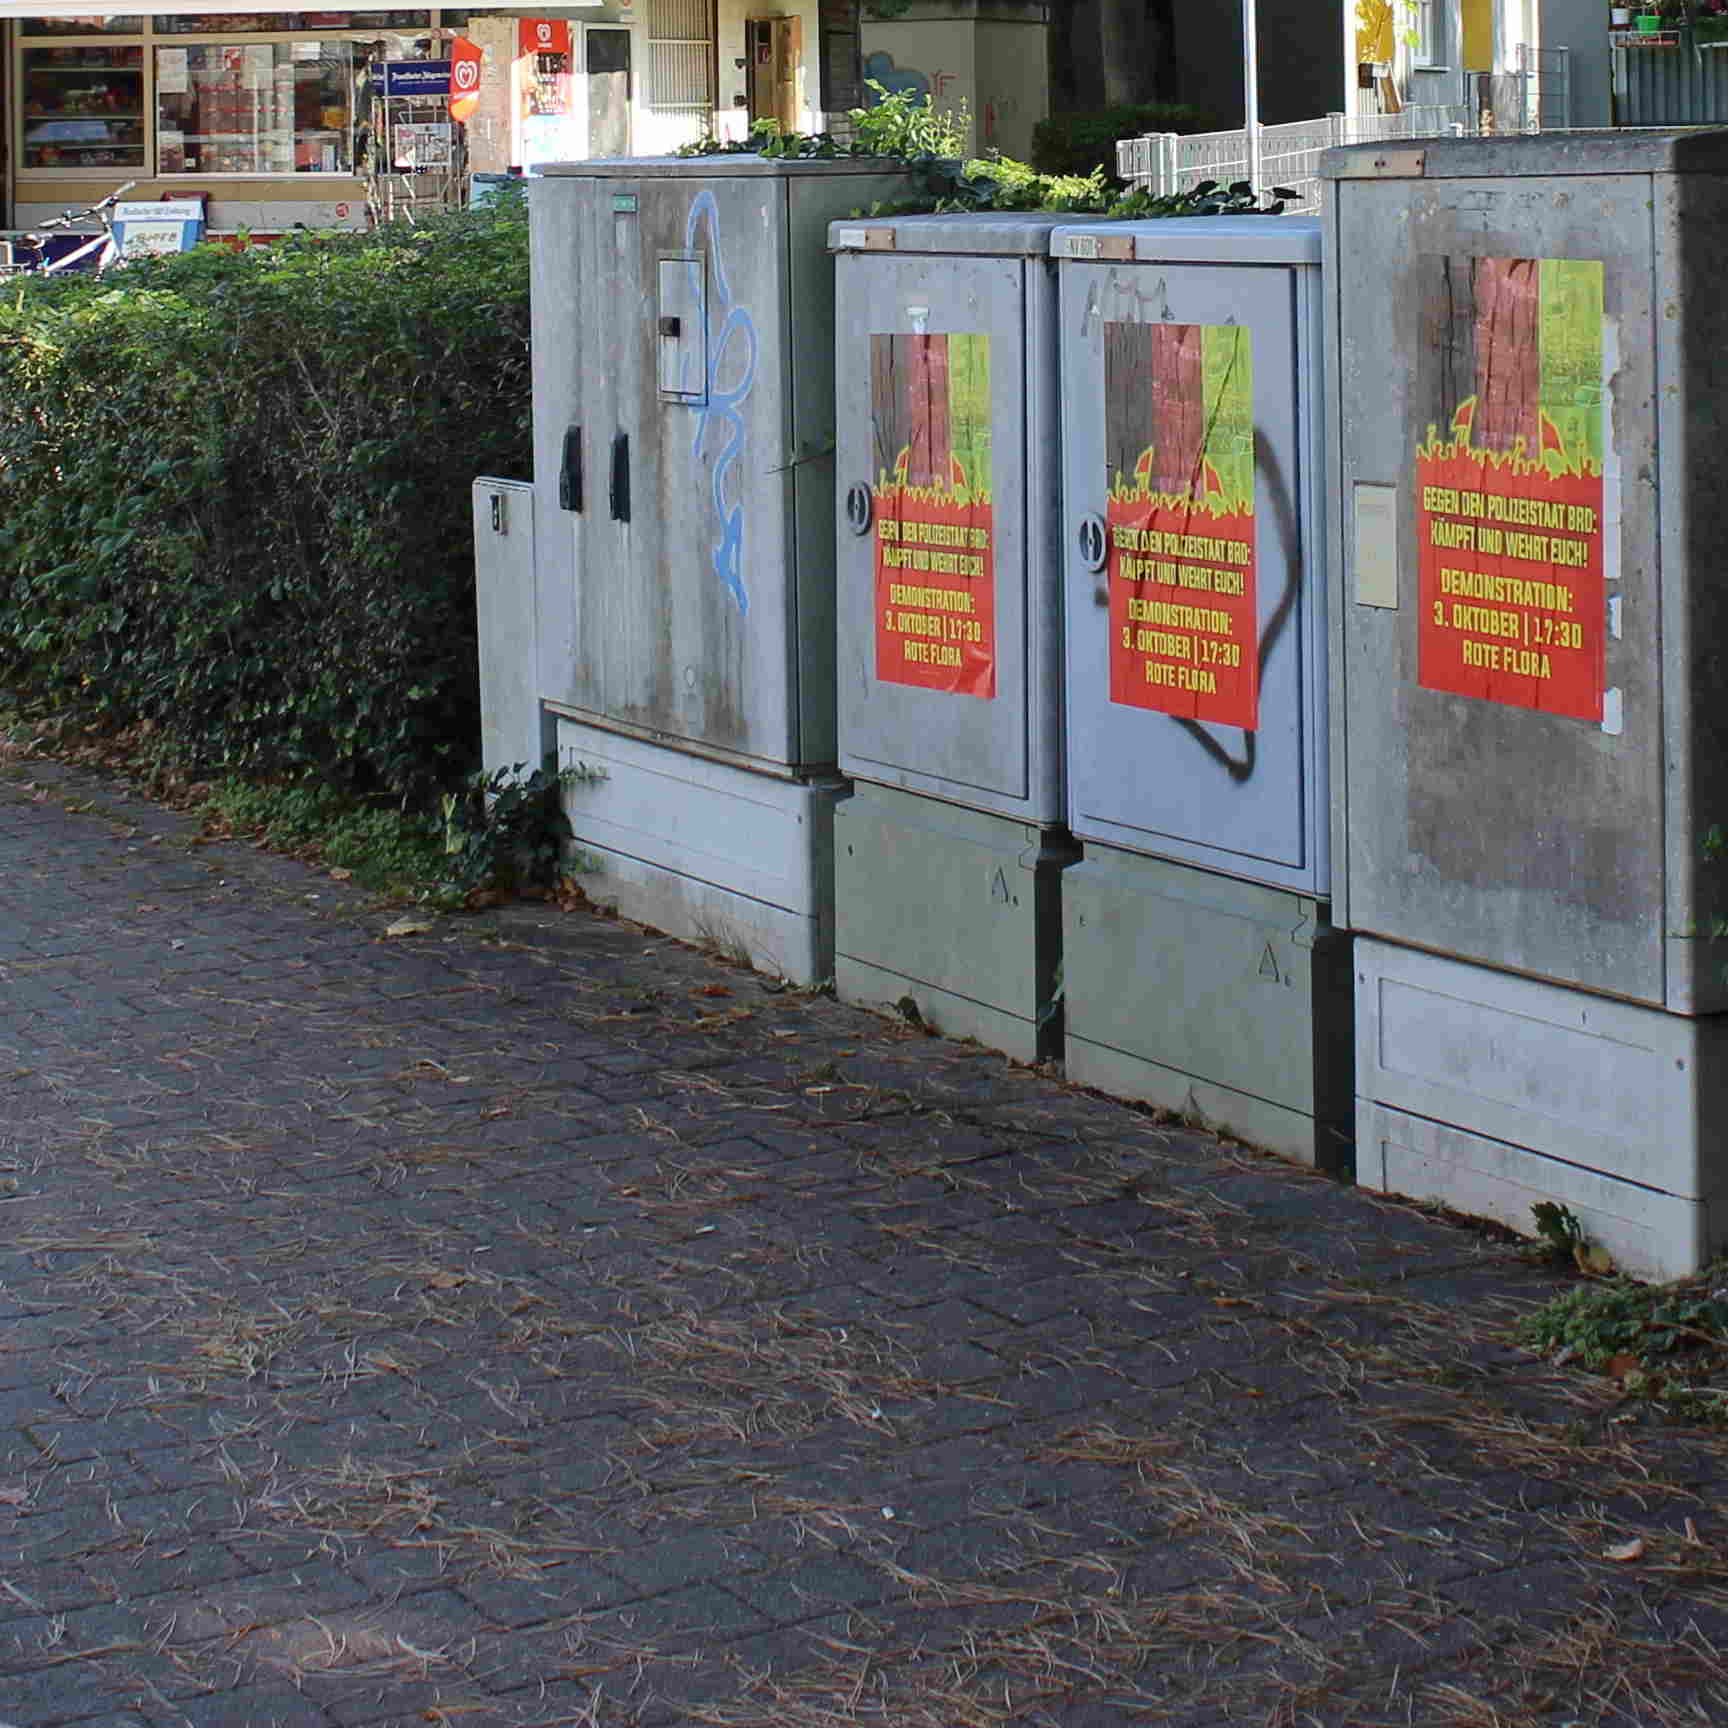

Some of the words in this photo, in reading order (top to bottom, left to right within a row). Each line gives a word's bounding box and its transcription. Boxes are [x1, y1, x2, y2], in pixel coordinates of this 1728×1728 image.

[1423, 486, 1459, 515] GEGEN
[1462, 491, 1484, 518] DEN
[1488, 494, 1565, 529] POLIZEISTAAT
[1568, 505, 1597, 534] BRD:
[1228, 541, 1251, 566] BRD:
[1431, 517, 1475, 551] KÄMPFT
[1478, 526, 1503, 554] UND
[1505, 531, 1548, 561] WEHRT
[1551, 538, 1588, 568] EUCH!
[890, 584, 975, 613] DEMONSTRATION:
[1178, 564, 1213, 592] WEHRT
[1215, 570, 1244, 596] EUCH!
[1441, 568, 1573, 612] DEMONSTRATION:
[885, 610, 896, 631] 3.
[897, 612, 941, 637] OKTOBER
[950, 619, 982, 641] 17:30
[1128, 598, 1232, 635] DEMONSTRATION:
[1434, 601, 1448, 627] 3.
[1453, 604, 1519, 638] OKTOBER
[1534, 617, 1583, 648] 17:30
[904, 640, 928, 663] ROTE
[930, 643, 962, 666] FLORA
[1122, 627, 1134, 649] 3.
[1137, 630, 1190, 660] OKTOBER
[1201, 639, 1240, 667] 17:30
[1463, 640, 1500, 670] ROTE
[1504, 646, 1551, 679] FLORA
[1145, 660, 1175, 687] ROTE
[1178, 666, 1216, 694] FLORA
